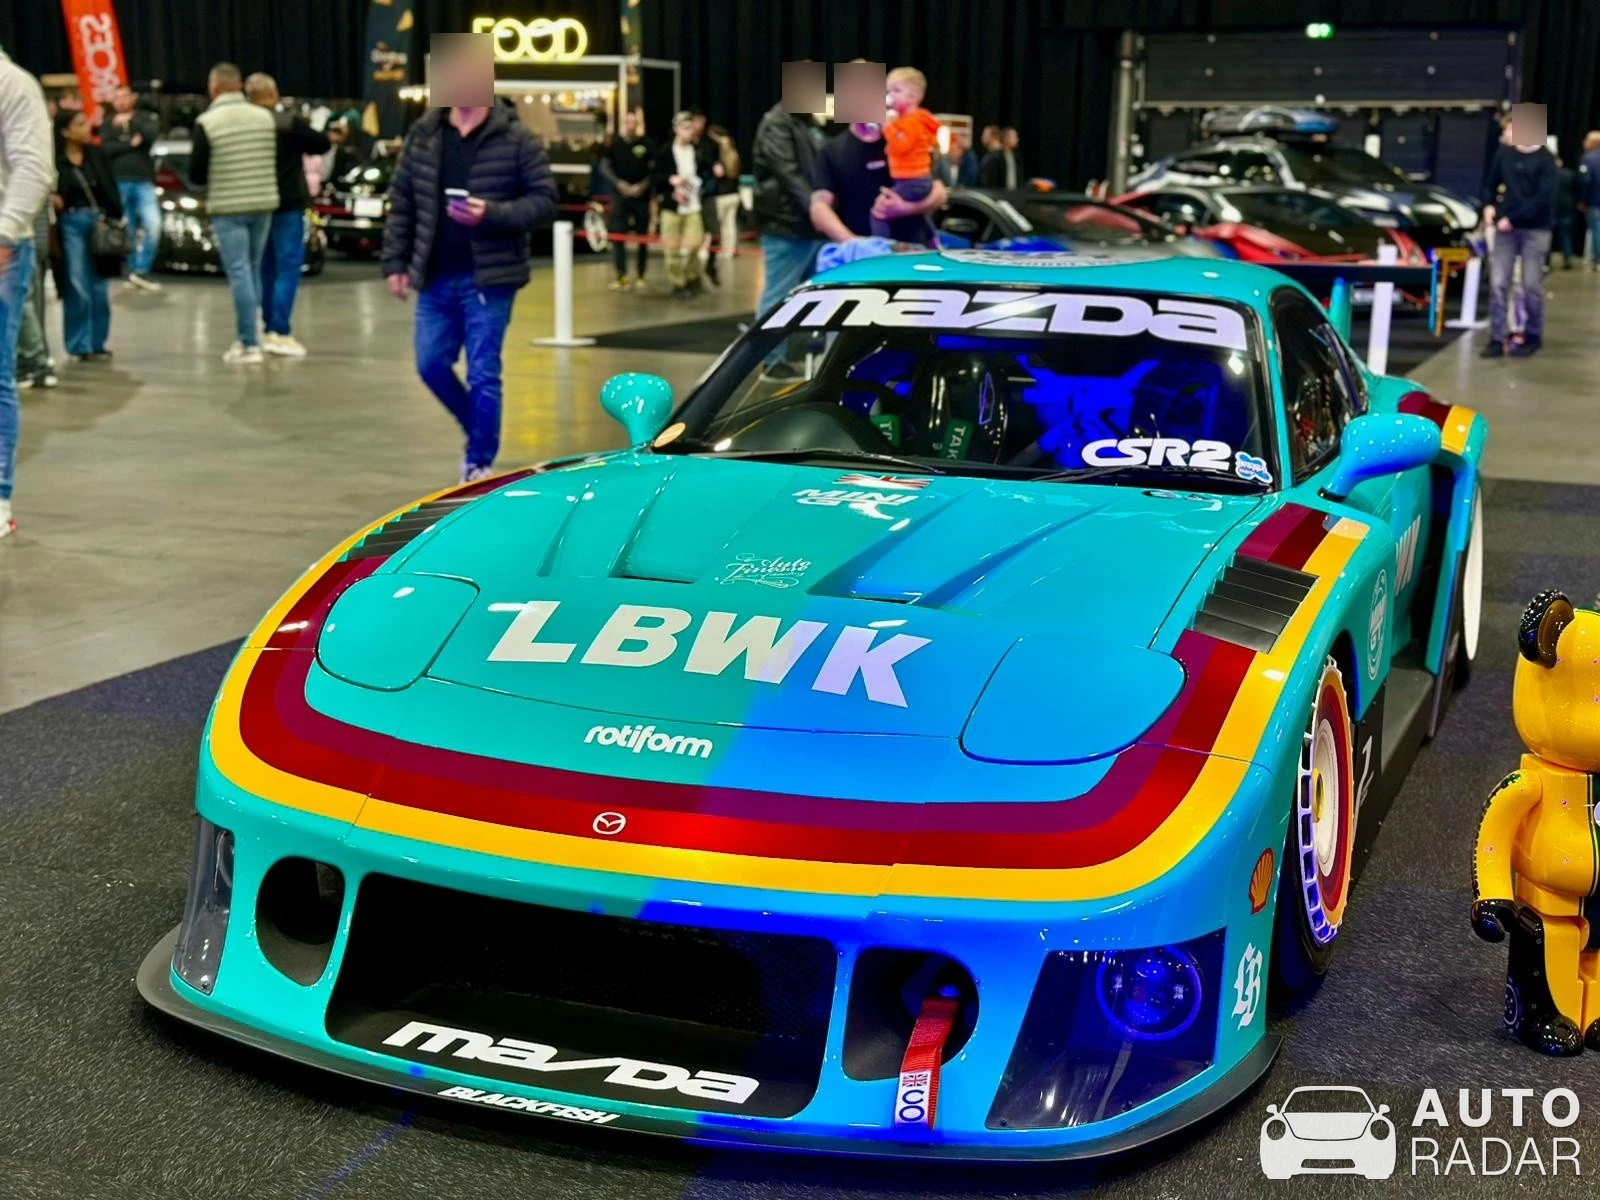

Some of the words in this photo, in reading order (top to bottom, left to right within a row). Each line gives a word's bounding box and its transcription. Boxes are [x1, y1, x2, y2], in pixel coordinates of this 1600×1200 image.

[1081, 438, 1232, 470] CSR2
[792, 488, 919, 507] MINI
[486, 600, 933, 708] LBWK
[583, 724, 714, 759] rotiform
[438, 1086, 622, 1124] BLACKFISH
